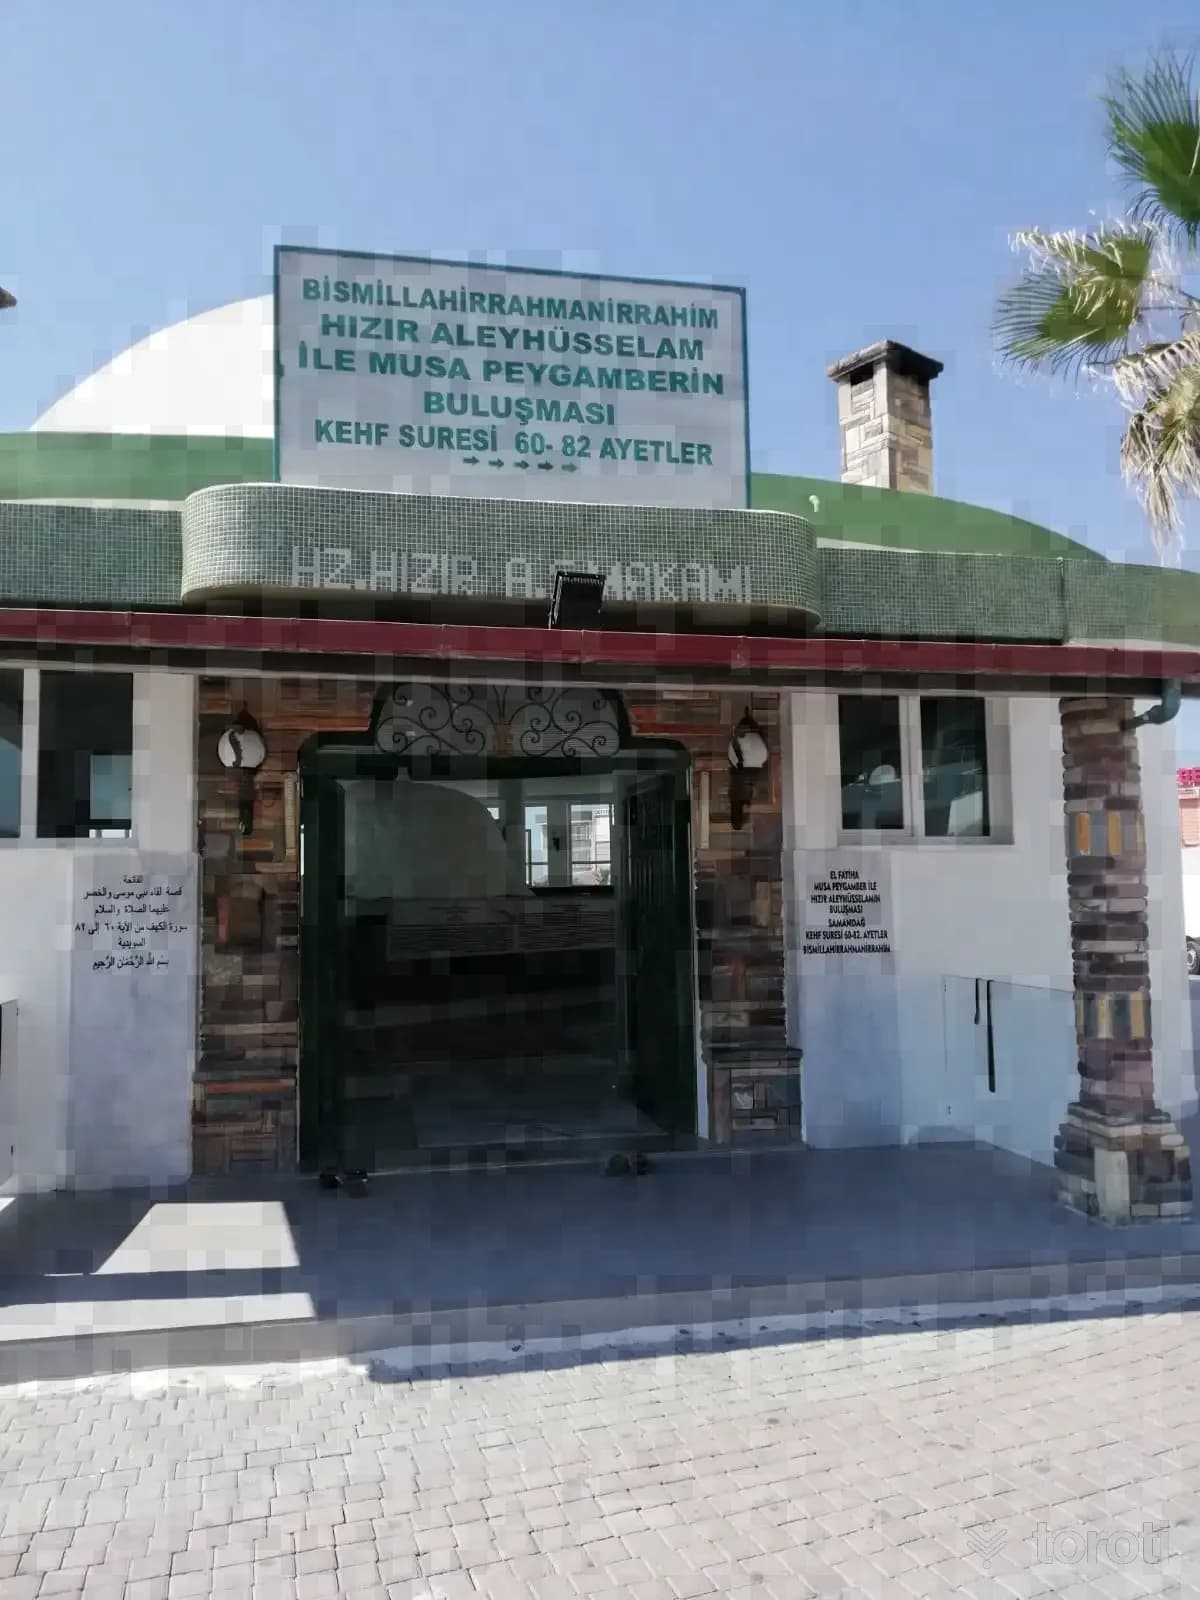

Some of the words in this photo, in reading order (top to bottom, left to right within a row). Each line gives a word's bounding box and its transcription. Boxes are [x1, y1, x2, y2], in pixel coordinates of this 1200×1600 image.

[303, 275, 718, 328] BİSMİLLAHİRRAHMANİRRAHİM
[321, 313, 419, 342] HIZIR
[431, 322, 704, 360] ALEYHÜSSELAM
[298, 341, 356, 372] İLE
[369, 351, 471, 380] MUSA
[483, 359, 724, 394] PEYGAMBERİN
[423, 391, 615, 426] BULUŞMASI
[315, 419, 390, 446] KEHF
[399, 424, 498, 452] SURESİ
[561, 434, 591, 458] 82
[599, 437, 713, 465] AYETLER
[814, 882, 831, 891] MUSA
[832, 882, 867, 891] PEYGAMBER
[828, 917, 865, 928] SAMANDAĞ
[829, 905, 863, 916] BULUŞMASI
[805, 930, 821, 940] KEHF
